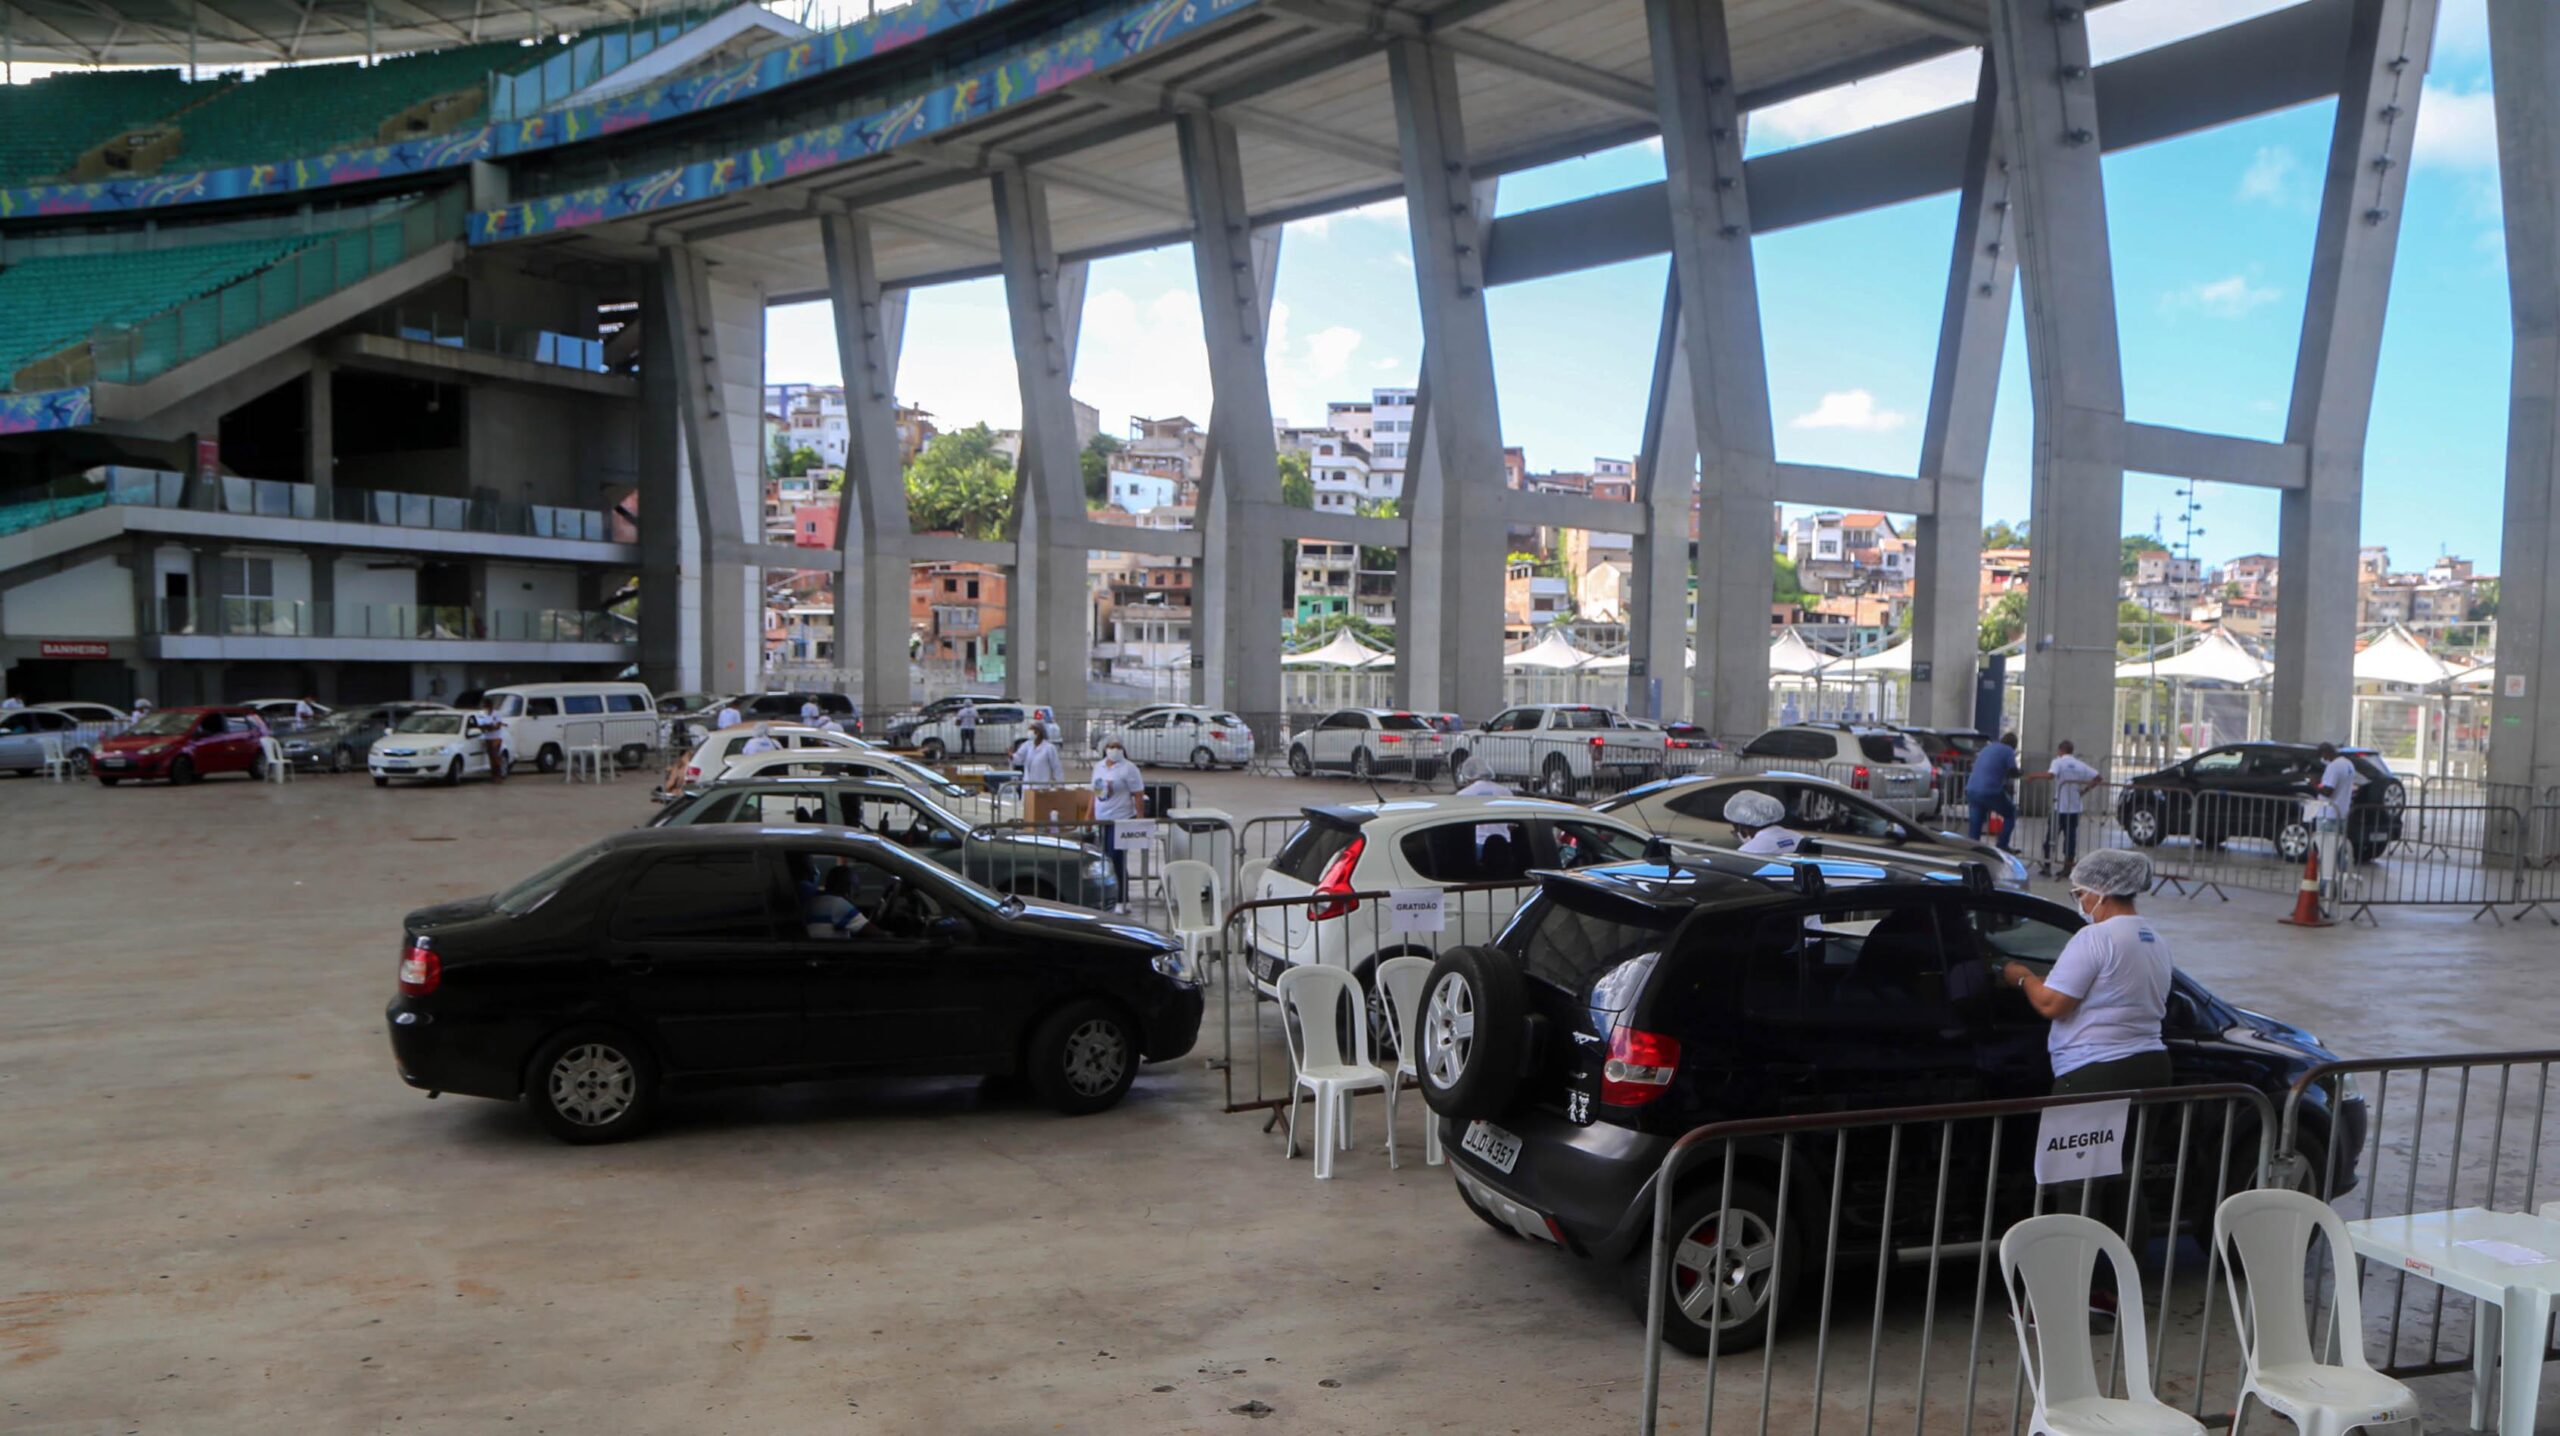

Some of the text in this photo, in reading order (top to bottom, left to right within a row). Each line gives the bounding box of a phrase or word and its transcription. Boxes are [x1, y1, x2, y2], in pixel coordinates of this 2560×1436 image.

[43, 645, 107, 655] BANHEIRO
[1120, 831, 1147, 839] AMOR
[1396, 901, 1438, 911] GRATIDÃO
[2046, 1129, 2115, 1152] ALEGRIA
